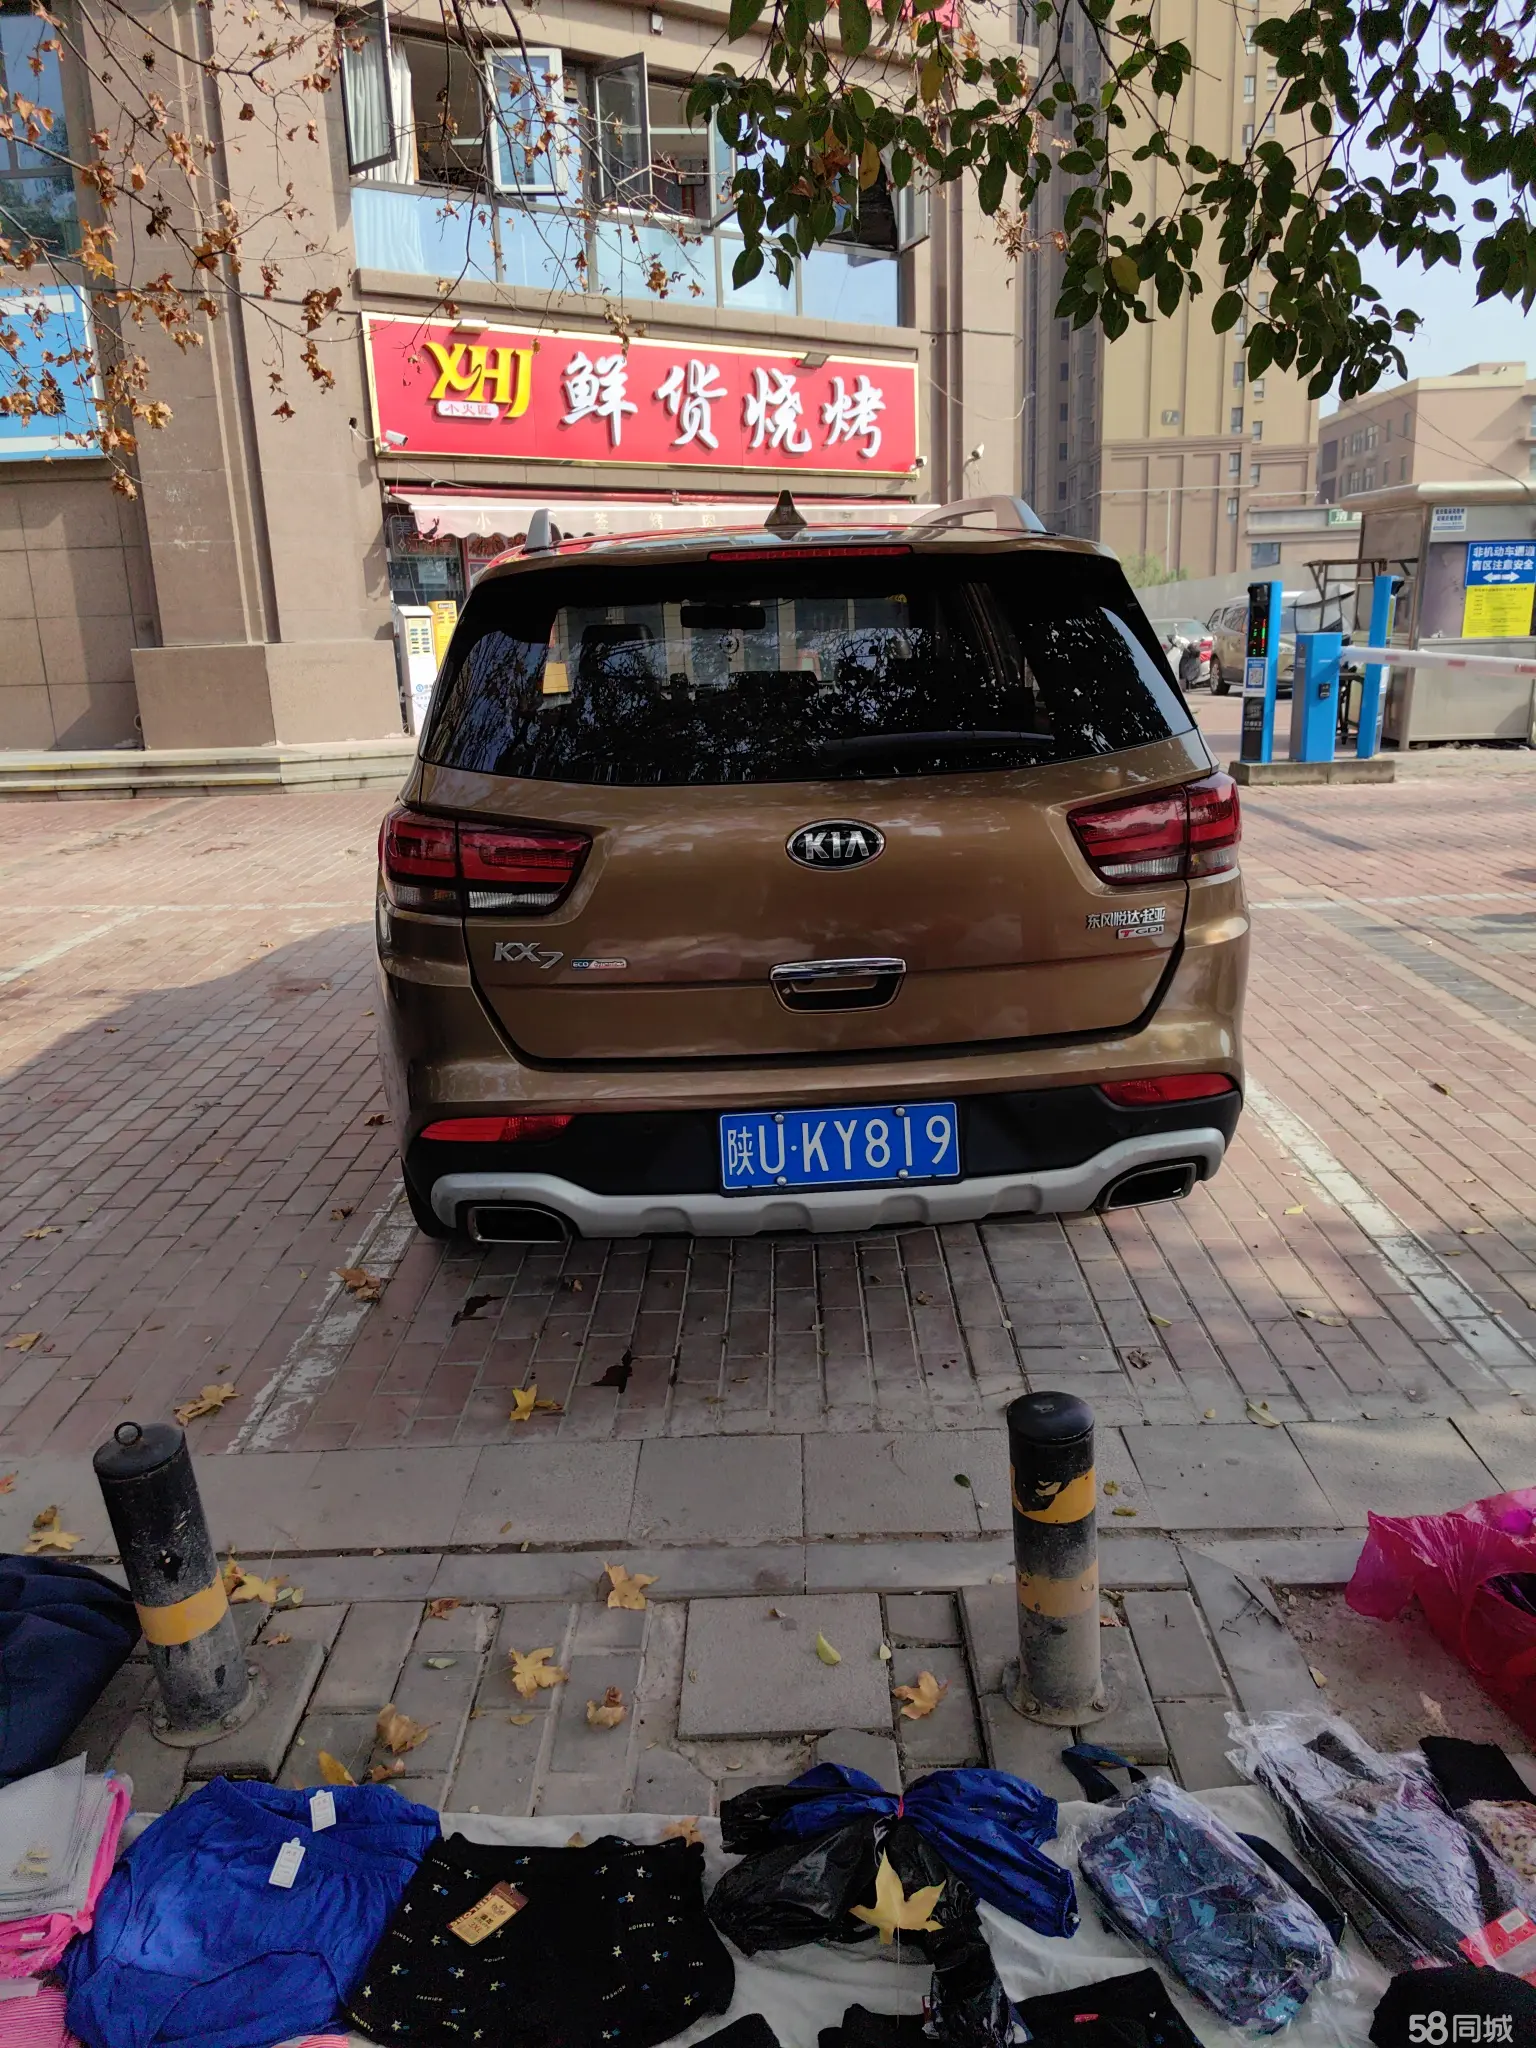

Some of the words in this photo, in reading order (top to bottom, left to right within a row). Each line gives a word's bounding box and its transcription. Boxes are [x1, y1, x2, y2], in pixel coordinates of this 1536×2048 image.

[559, 351, 887, 458] 鲜货烧烤
[1471, 559, 1534, 571] 盲区注意安全
[1472, 545, 1535, 558] 非机动车通道
[804, 830, 870, 860] KIA
[493, 942, 564, 969] KX7
[727, 1115, 951, 1176] 陕U·KY819
[602, 1985, 627, 2001] FASHION
